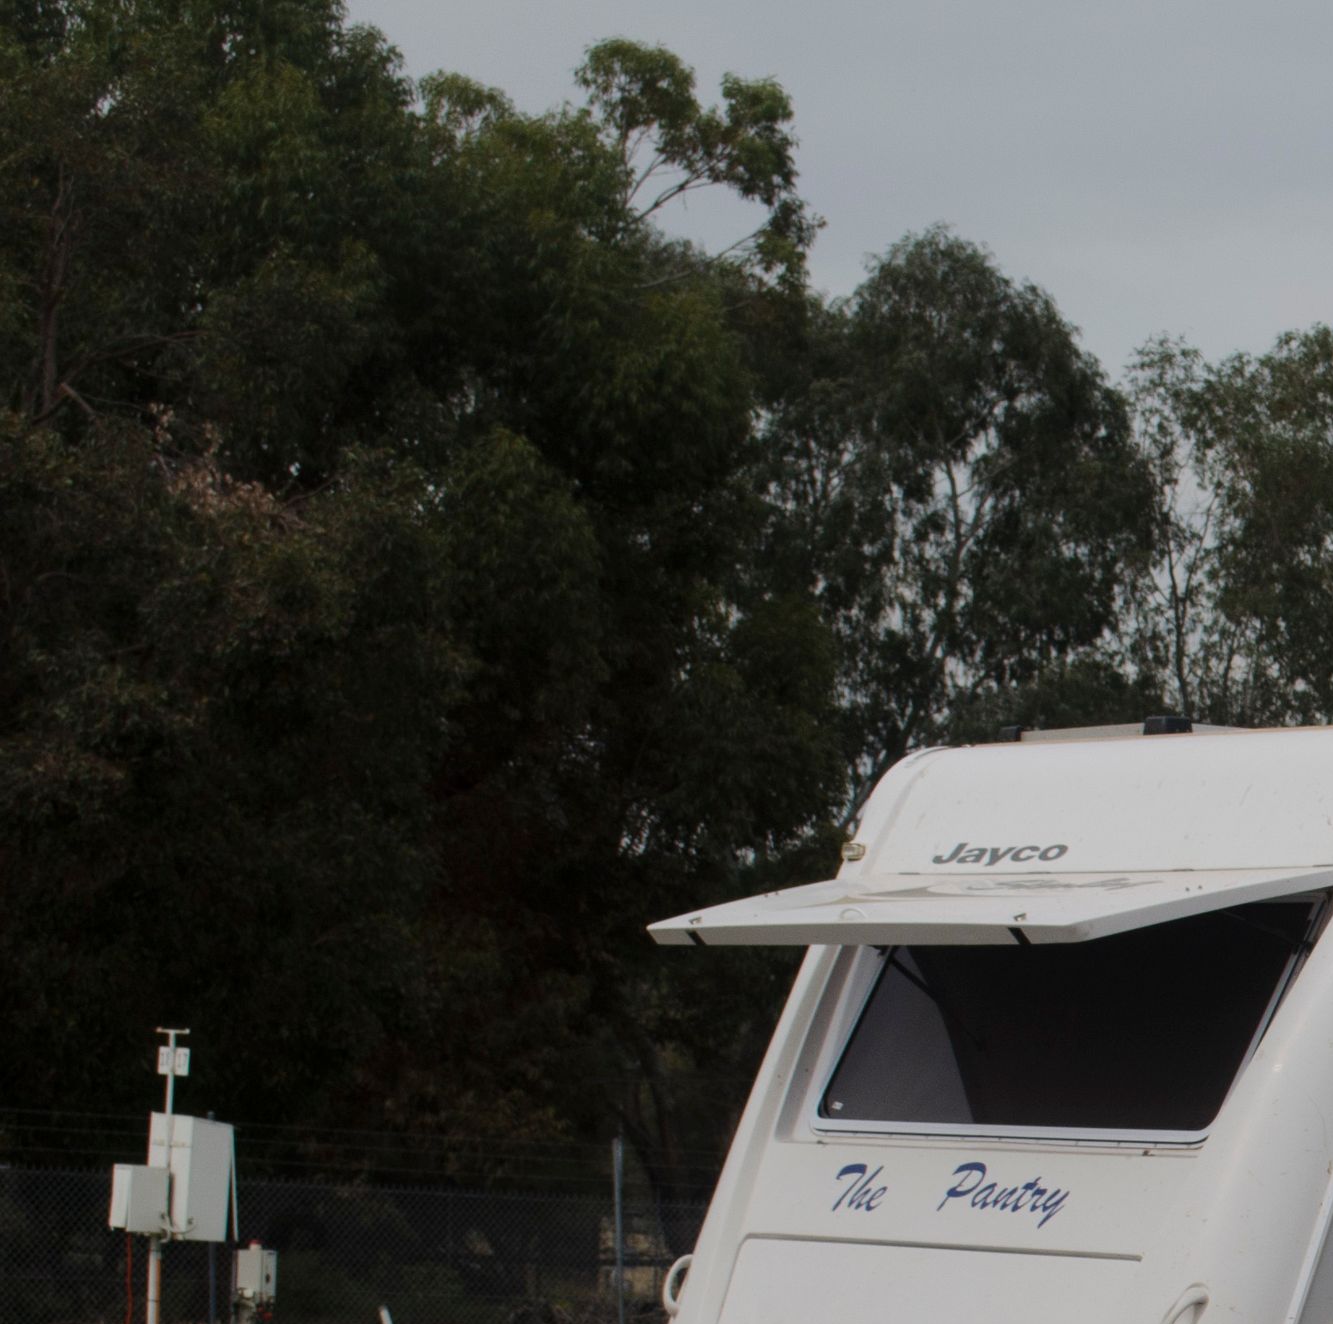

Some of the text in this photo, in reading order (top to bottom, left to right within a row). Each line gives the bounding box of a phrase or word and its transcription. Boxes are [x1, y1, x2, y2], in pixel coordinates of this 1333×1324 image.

[932, 842, 1068, 867] Jayco
[832, 1162, 1070, 1229] The Pantry
